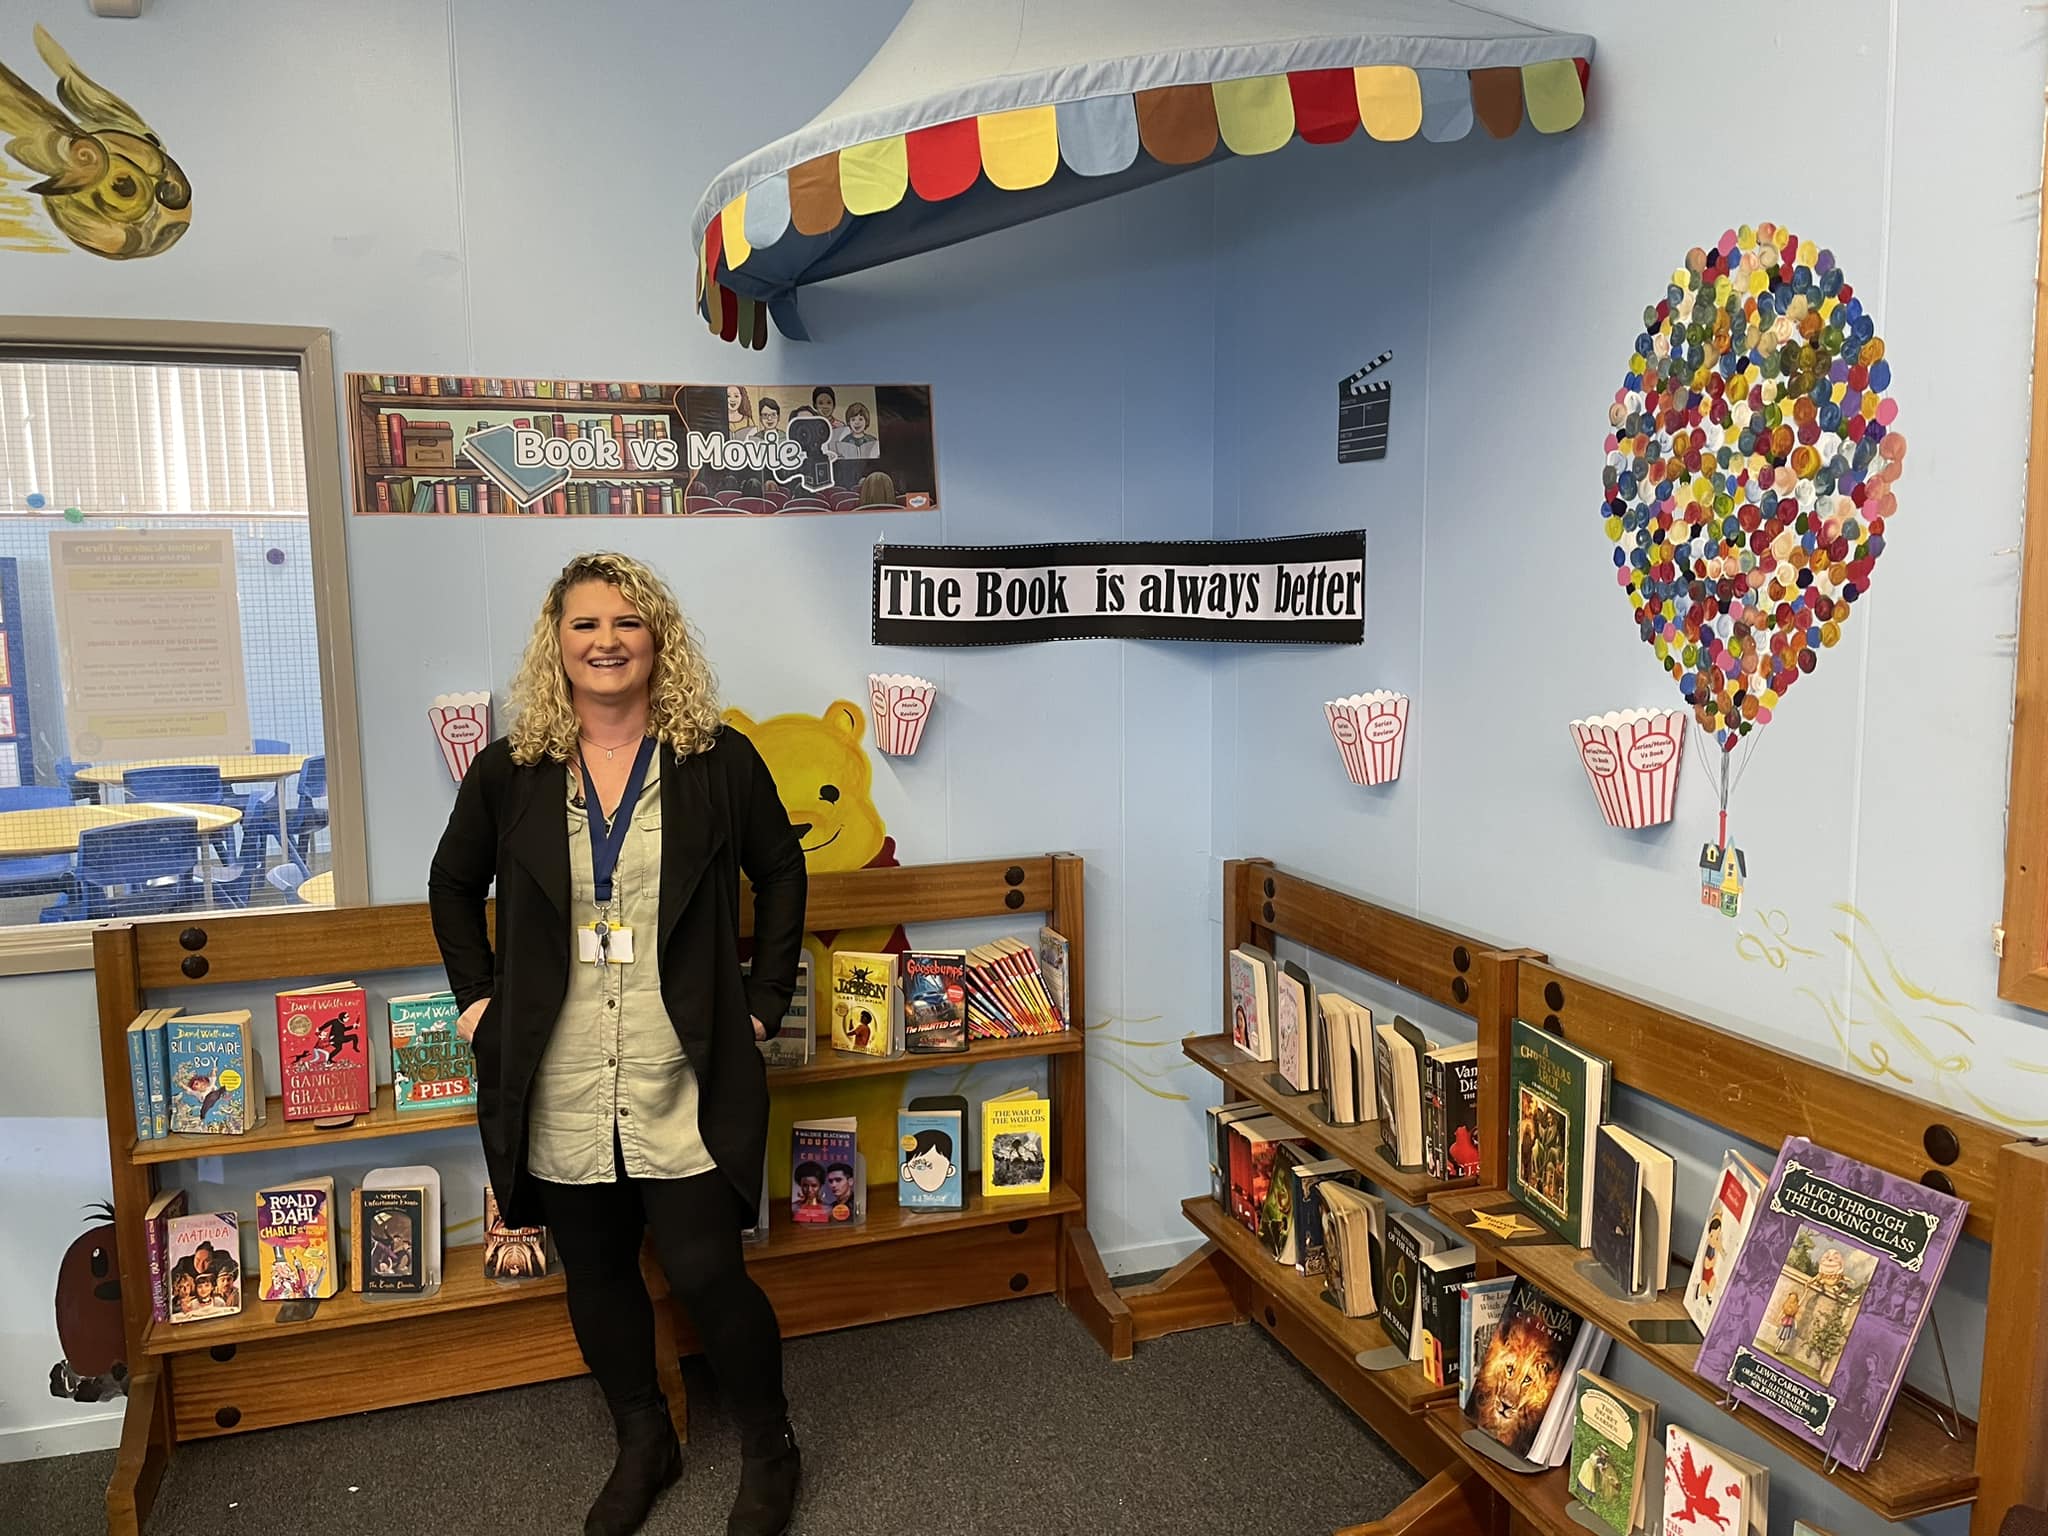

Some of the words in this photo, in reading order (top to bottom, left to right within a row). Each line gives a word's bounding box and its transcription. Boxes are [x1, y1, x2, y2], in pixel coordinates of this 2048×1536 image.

[516, 429, 619, 468] Book
[631, 436, 678, 468] vs
[688, 431, 802, 470] Movie
[884, 568, 961, 618] The
[975, 568, 1069, 618] Book
[1095, 567, 1125, 614] is
[1139, 566, 1260, 619] always
[1274, 565, 1360, 618] better
[1373, 729, 1394, 737] Review
[1374, 720, 1392, 728] Series
[1650, 750, 1664, 758] Book
[907, 959, 963, 979] Goosebumps
[834, 978, 888, 1001] JACKSON
[396, 1007, 430, 1023] David
[432, 1005, 459, 1018] Wall
[174, 1028, 199, 1039] David
[398, 1042, 475, 1062] WORLD
[194, 1056, 218, 1068] BOY
[1520, 1044, 1572, 1085] CHRISTMAS
[291, 1072, 358, 1089] GANGSTA
[420, 1080, 464, 1099] PETS
[1460, 1079, 1477, 1093] Dia
[992, 1117, 1009, 1125] THE
[1010, 1116, 1045, 1124] WORLDS
[270, 1194, 317, 1211] ROALD
[1800, 1182, 1837, 1205] ALICE
[1838, 1195, 1908, 1234] THROUGH
[271, 1208, 318, 1226] DAHL
[1784, 1188, 1811, 1209] THE
[1810, 1199, 1872, 1235] LOOKING
[1872, 1226, 1917, 1254] GLASS
[177, 1227, 230, 1244] MATILDA
[260, 1225, 297, 1240] CHARLIE
[1514, 1288, 1573, 1336] NARNIA
[1742, 1367, 1768, 1386] ORIGINAL
[1767, 1380, 1810, 1410] ILLUSTRATIONS
[1756, 1364, 1778, 1382] LEWIS
[1778, 1376, 1810, 1401] CARROLL
[1760, 1384, 1778, 1400] JOHN
[1666, 1518, 1684, 1534] THE
